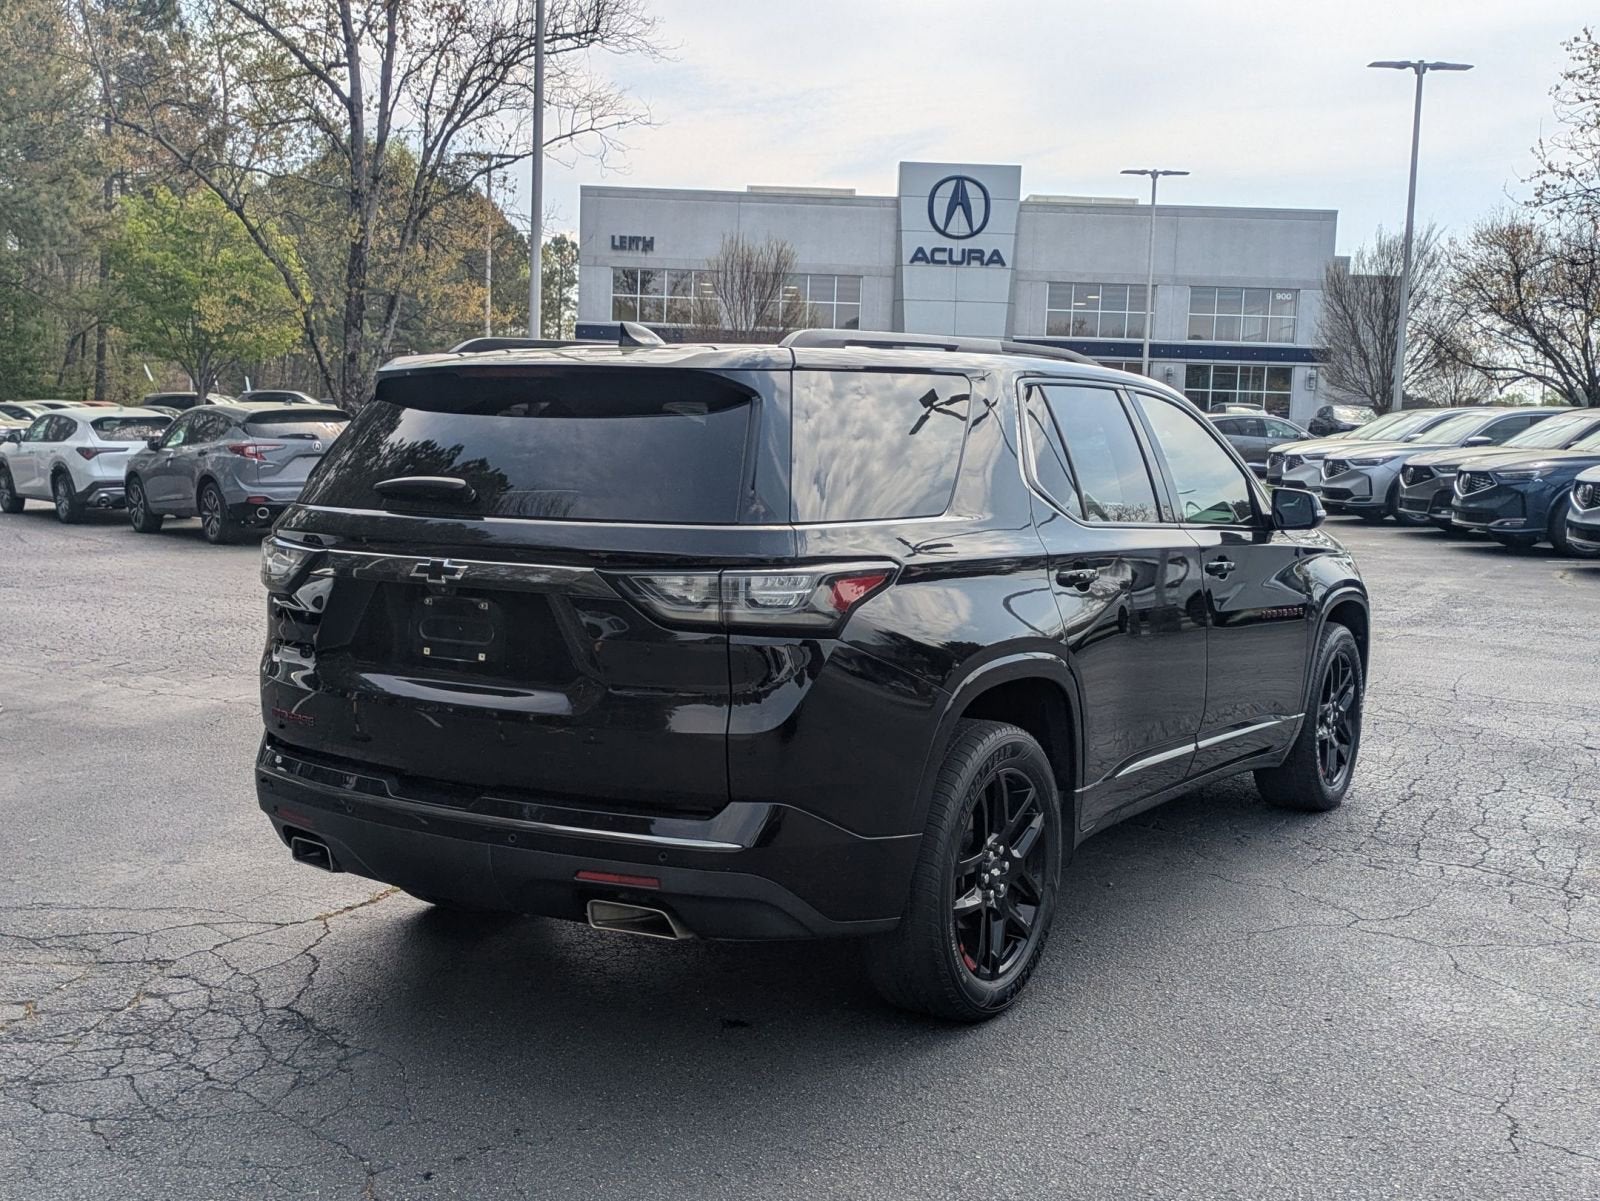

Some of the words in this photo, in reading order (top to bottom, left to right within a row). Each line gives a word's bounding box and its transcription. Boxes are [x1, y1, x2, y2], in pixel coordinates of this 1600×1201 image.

[611, 234, 654, 251] LEITH
[909, 246, 1007, 267] ACURA
[1276, 292, 1292, 301] 900
